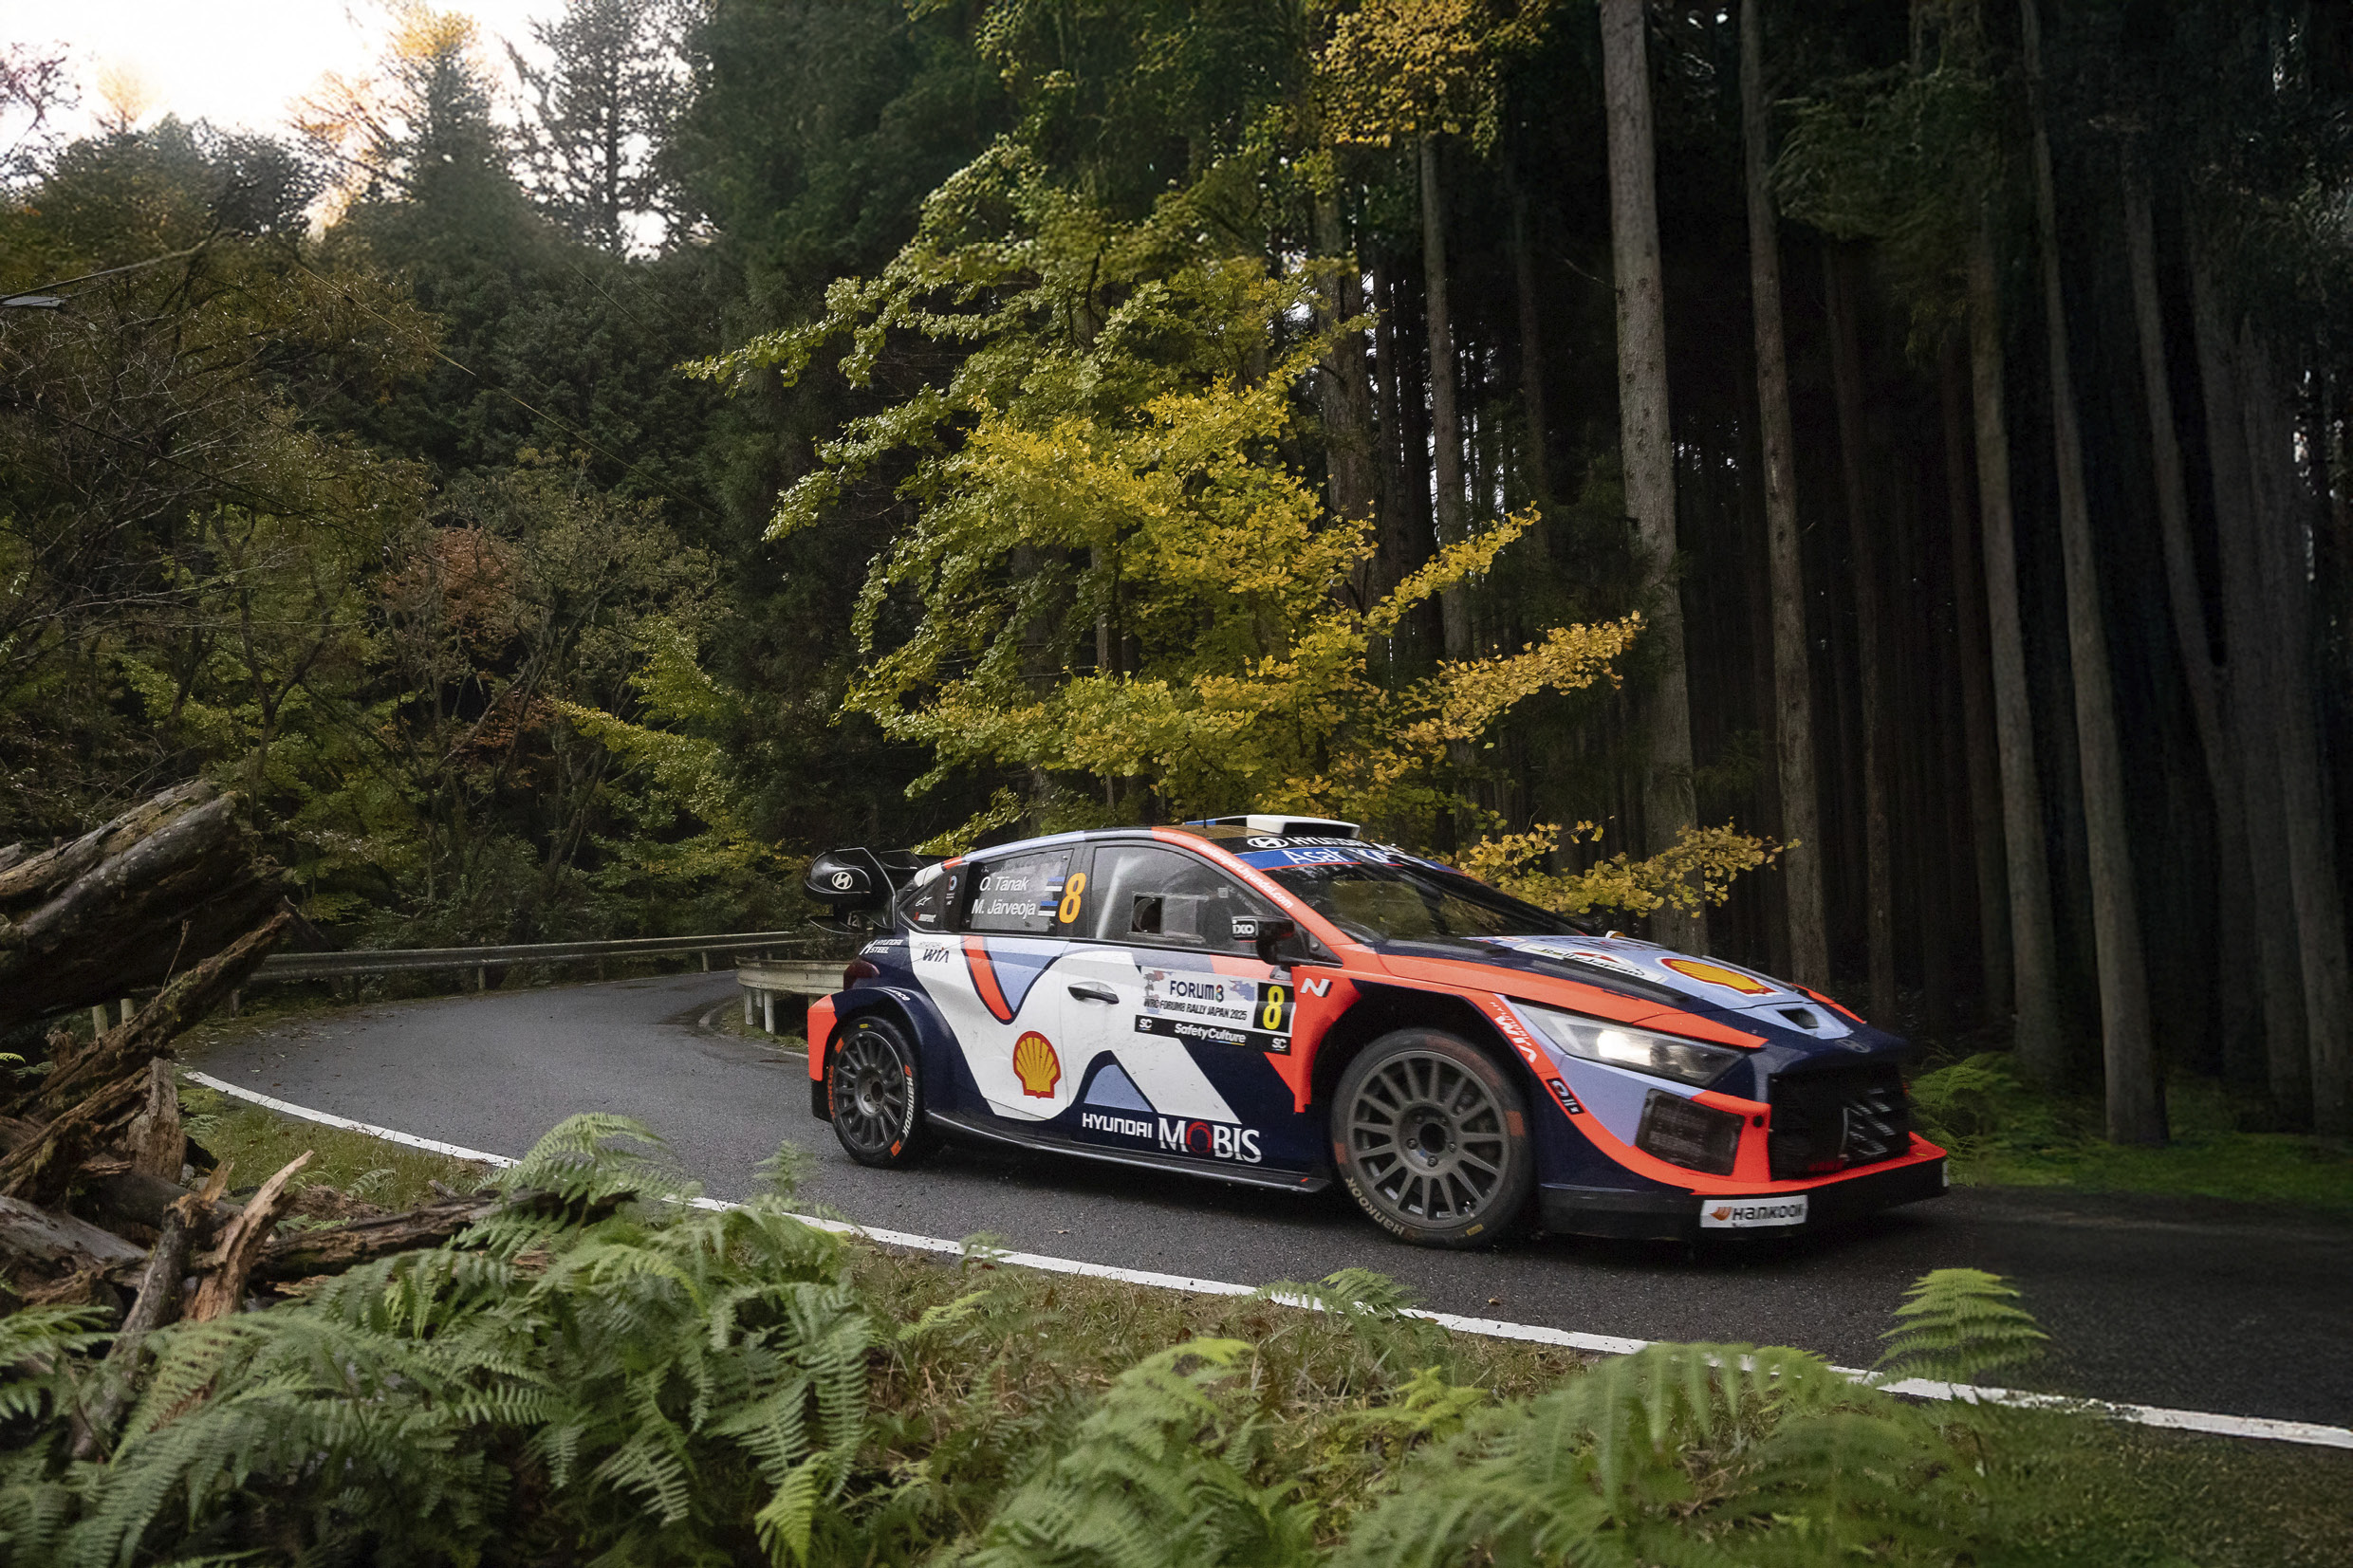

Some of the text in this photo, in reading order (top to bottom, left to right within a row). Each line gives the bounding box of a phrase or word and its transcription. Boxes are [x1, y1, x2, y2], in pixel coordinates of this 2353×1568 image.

[979, 876, 991, 892] O.
[1197, 843, 1294, 909] motorsport.hyundai.com
[971, 898, 984, 914] M.
[987, 898, 1036, 920] Järveoja
[1059, 872, 1086, 924] 8
[1300, 977, 1331, 997] N
[1143, 998, 1160, 1008] WRC
[1187, 1004, 1207, 1015] RALLY
[1207, 1005, 1230, 1018] JAPAN
[1230, 1009, 1248, 1021] 2025
[1263, 986, 1286, 1030] 8
[1139, 1018, 1287, 1049] SC SafetyCulture SC
[1083, 1112, 1262, 1164] HYUNDAI MOBIS
